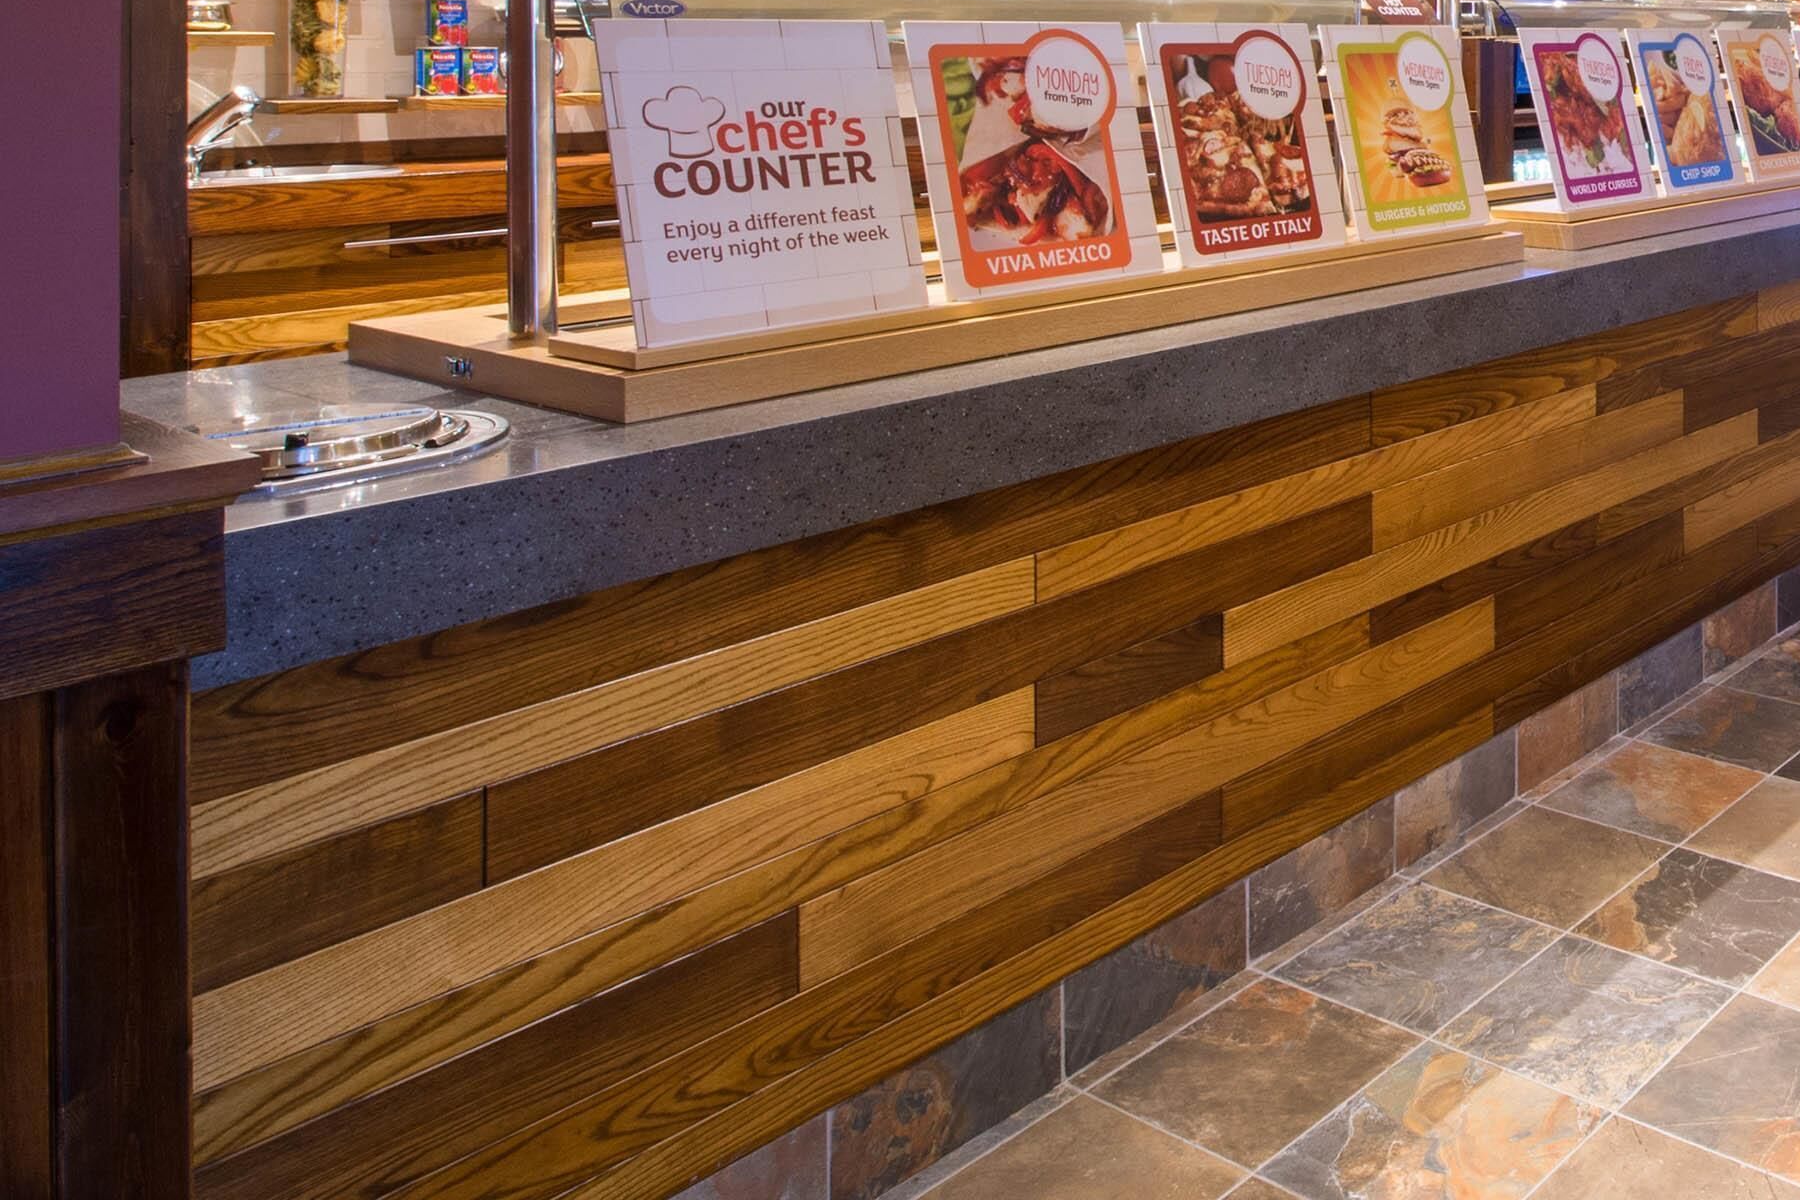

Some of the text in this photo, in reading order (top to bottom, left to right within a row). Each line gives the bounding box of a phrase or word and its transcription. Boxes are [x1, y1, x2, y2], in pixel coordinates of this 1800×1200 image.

[629, 1, 680, 16] Victor
[1377, 6, 1423, 16] COUNTER
[1036, 65, 1099, 96] MONDAY
[1244, 62, 1293, 89] TUESDAY
[1044, 90, 1093, 107] from 5pm
[1250, 83, 1288, 98] from 5pm
[761, 100, 805, 119] our
[716, 108, 866, 153] chef's
[654, 151, 876, 198] COUNTER
[1681, 165, 1721, 181] CHIP SHOP
[1570, 177, 1638, 196] WORLD OF CURRIES
[663, 205, 876, 241] Enjoy a different feast
[1374, 200, 1466, 222] BURGERS & HOTDOGS
[1201, 217, 1313, 246] TASTE OF ITALY
[667, 225, 889, 263] every night of the week
[986, 243, 1112, 275] VIVA MEXICO
